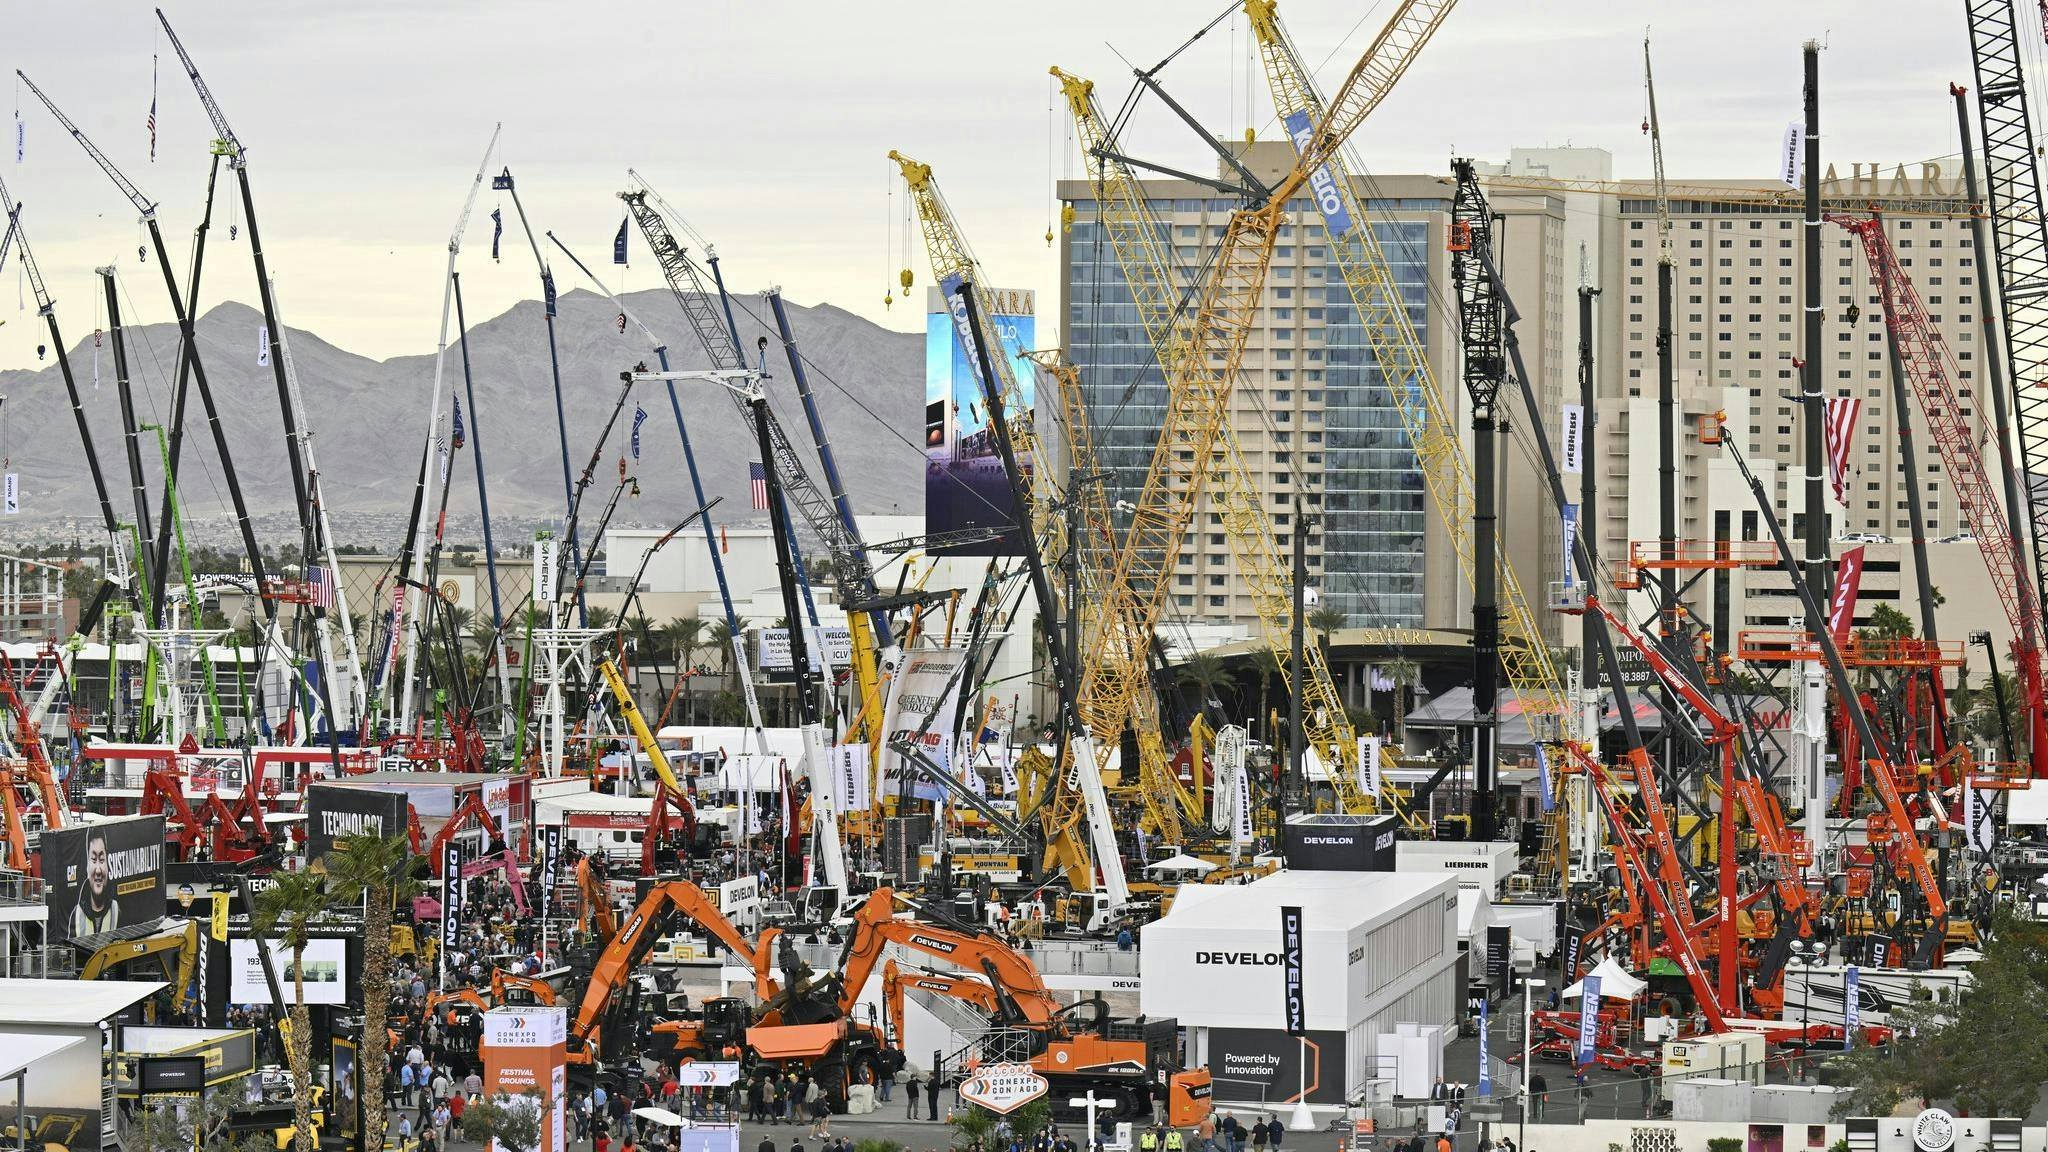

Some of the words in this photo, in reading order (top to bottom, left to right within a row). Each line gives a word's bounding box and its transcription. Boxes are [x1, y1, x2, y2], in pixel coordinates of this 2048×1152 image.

[1294, 127, 1341, 216] KOELCO
[1567, 411, 1577, 468] LIEBHERR
[779, 449, 799, 477] GROVE
[540, 554, 549, 600] MERLO
[1830, 556, 1853, 633] ANY
[1364, 630, 1433, 644] SAHARA
[844, 751, 855, 805] LIEBHERR
[1363, 743, 1372, 796] LIEBHERR
[321, 810, 383, 839] TECHNOLOGY
[1303, 836, 1354, 845] DEVELON
[107, 844, 161, 881] SUSTAINABILITY
[1444, 861, 1489, 869] LIEBHERR
[446, 849, 458, 947] DEVELON
[730, 885, 756, 904] DEVELON
[622, 916, 643, 944] DOOSAN
[916, 937, 952, 952] DEVELON
[1287, 915, 1300, 1031] DEVELON
[1567, 936, 1579, 986] DINGL
[200, 931, 208, 1028] DOOSA
[920, 980, 949, 991] DEVELON
[1582, 992, 1600, 1052] TEUPEN
[1225, 1053, 1266, 1064] Powered
[1268, 1053, 1280, 1066] by
[1480, 1017, 1489, 1082] TEUPEN
[498, 1077, 536, 1085] GROUNDS
[977, 1066, 1032, 1075] WELCOME
[992, 1077, 1038, 1086] CONEXPO
[1225, 1064, 1274, 1075] Innovation
[992, 1085, 1038, 1094] CON/AGG
[1917, 1115, 1930, 1136] WHITE
[1930, 1113, 1951, 1125] CLAW
